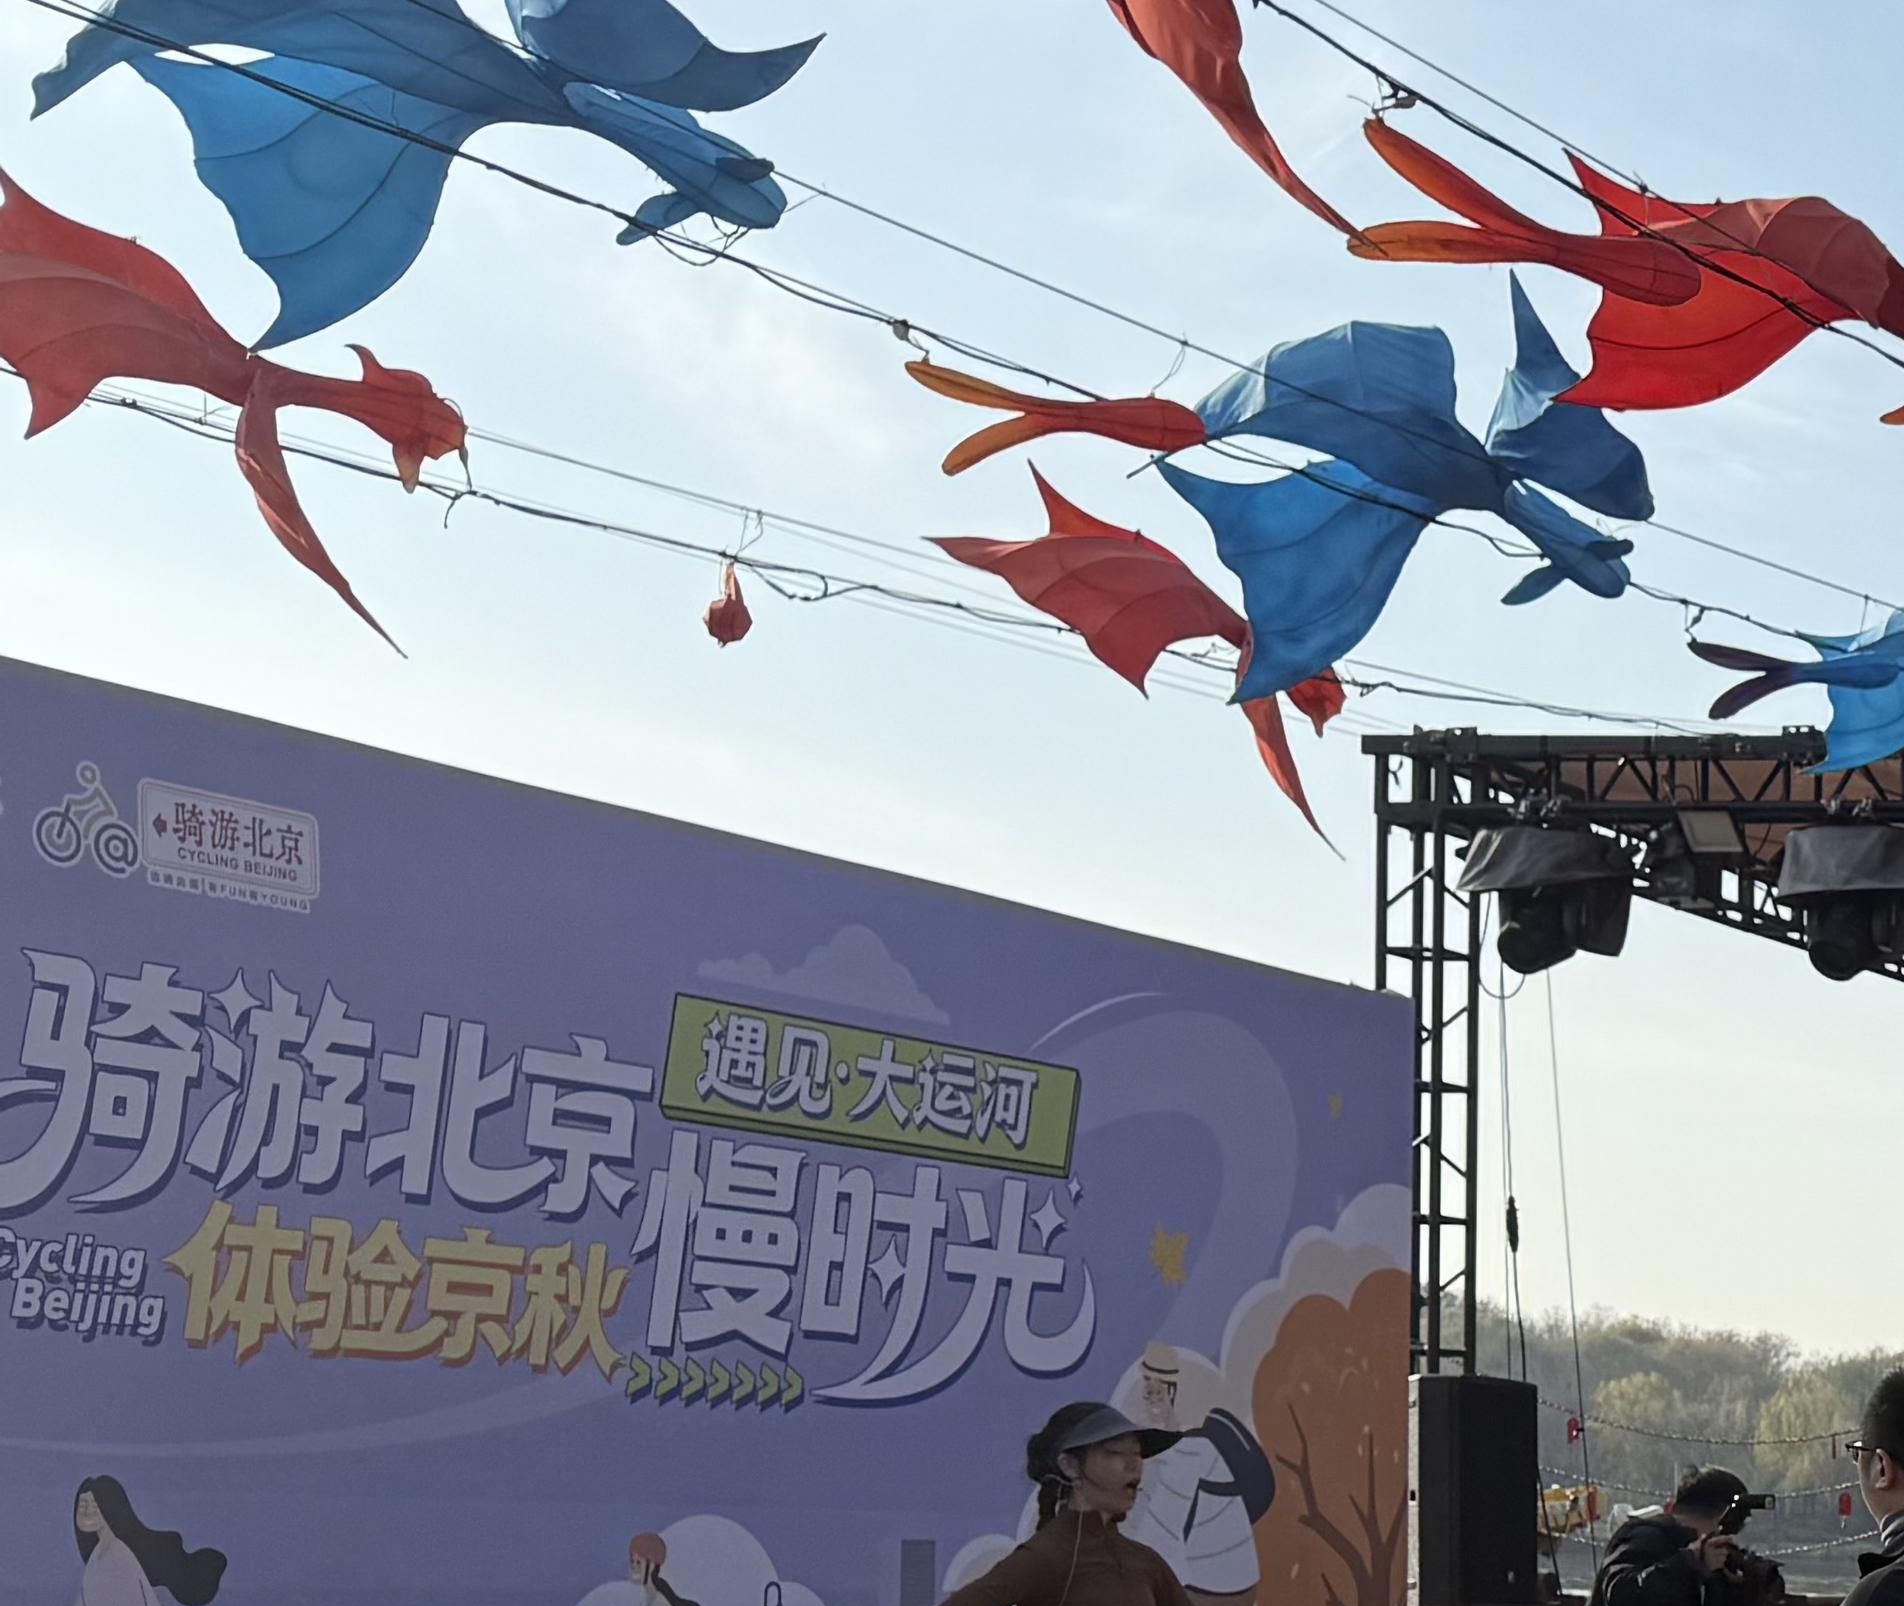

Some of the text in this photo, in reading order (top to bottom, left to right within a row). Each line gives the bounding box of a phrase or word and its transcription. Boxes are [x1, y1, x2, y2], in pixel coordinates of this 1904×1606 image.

[172, 802, 305, 866] 骑游北京
[177, 846, 298, 883] CYCLING BEIJING
[0, 946, 656, 1216] 骑游北京
[696, 1008, 1040, 1150] 遇见·大运河
[11, 1277, 166, 1337] Beijing
[163, 1197, 634, 1378] 体验京秋
[632, 1126, 1098, 1405] 慢时光
